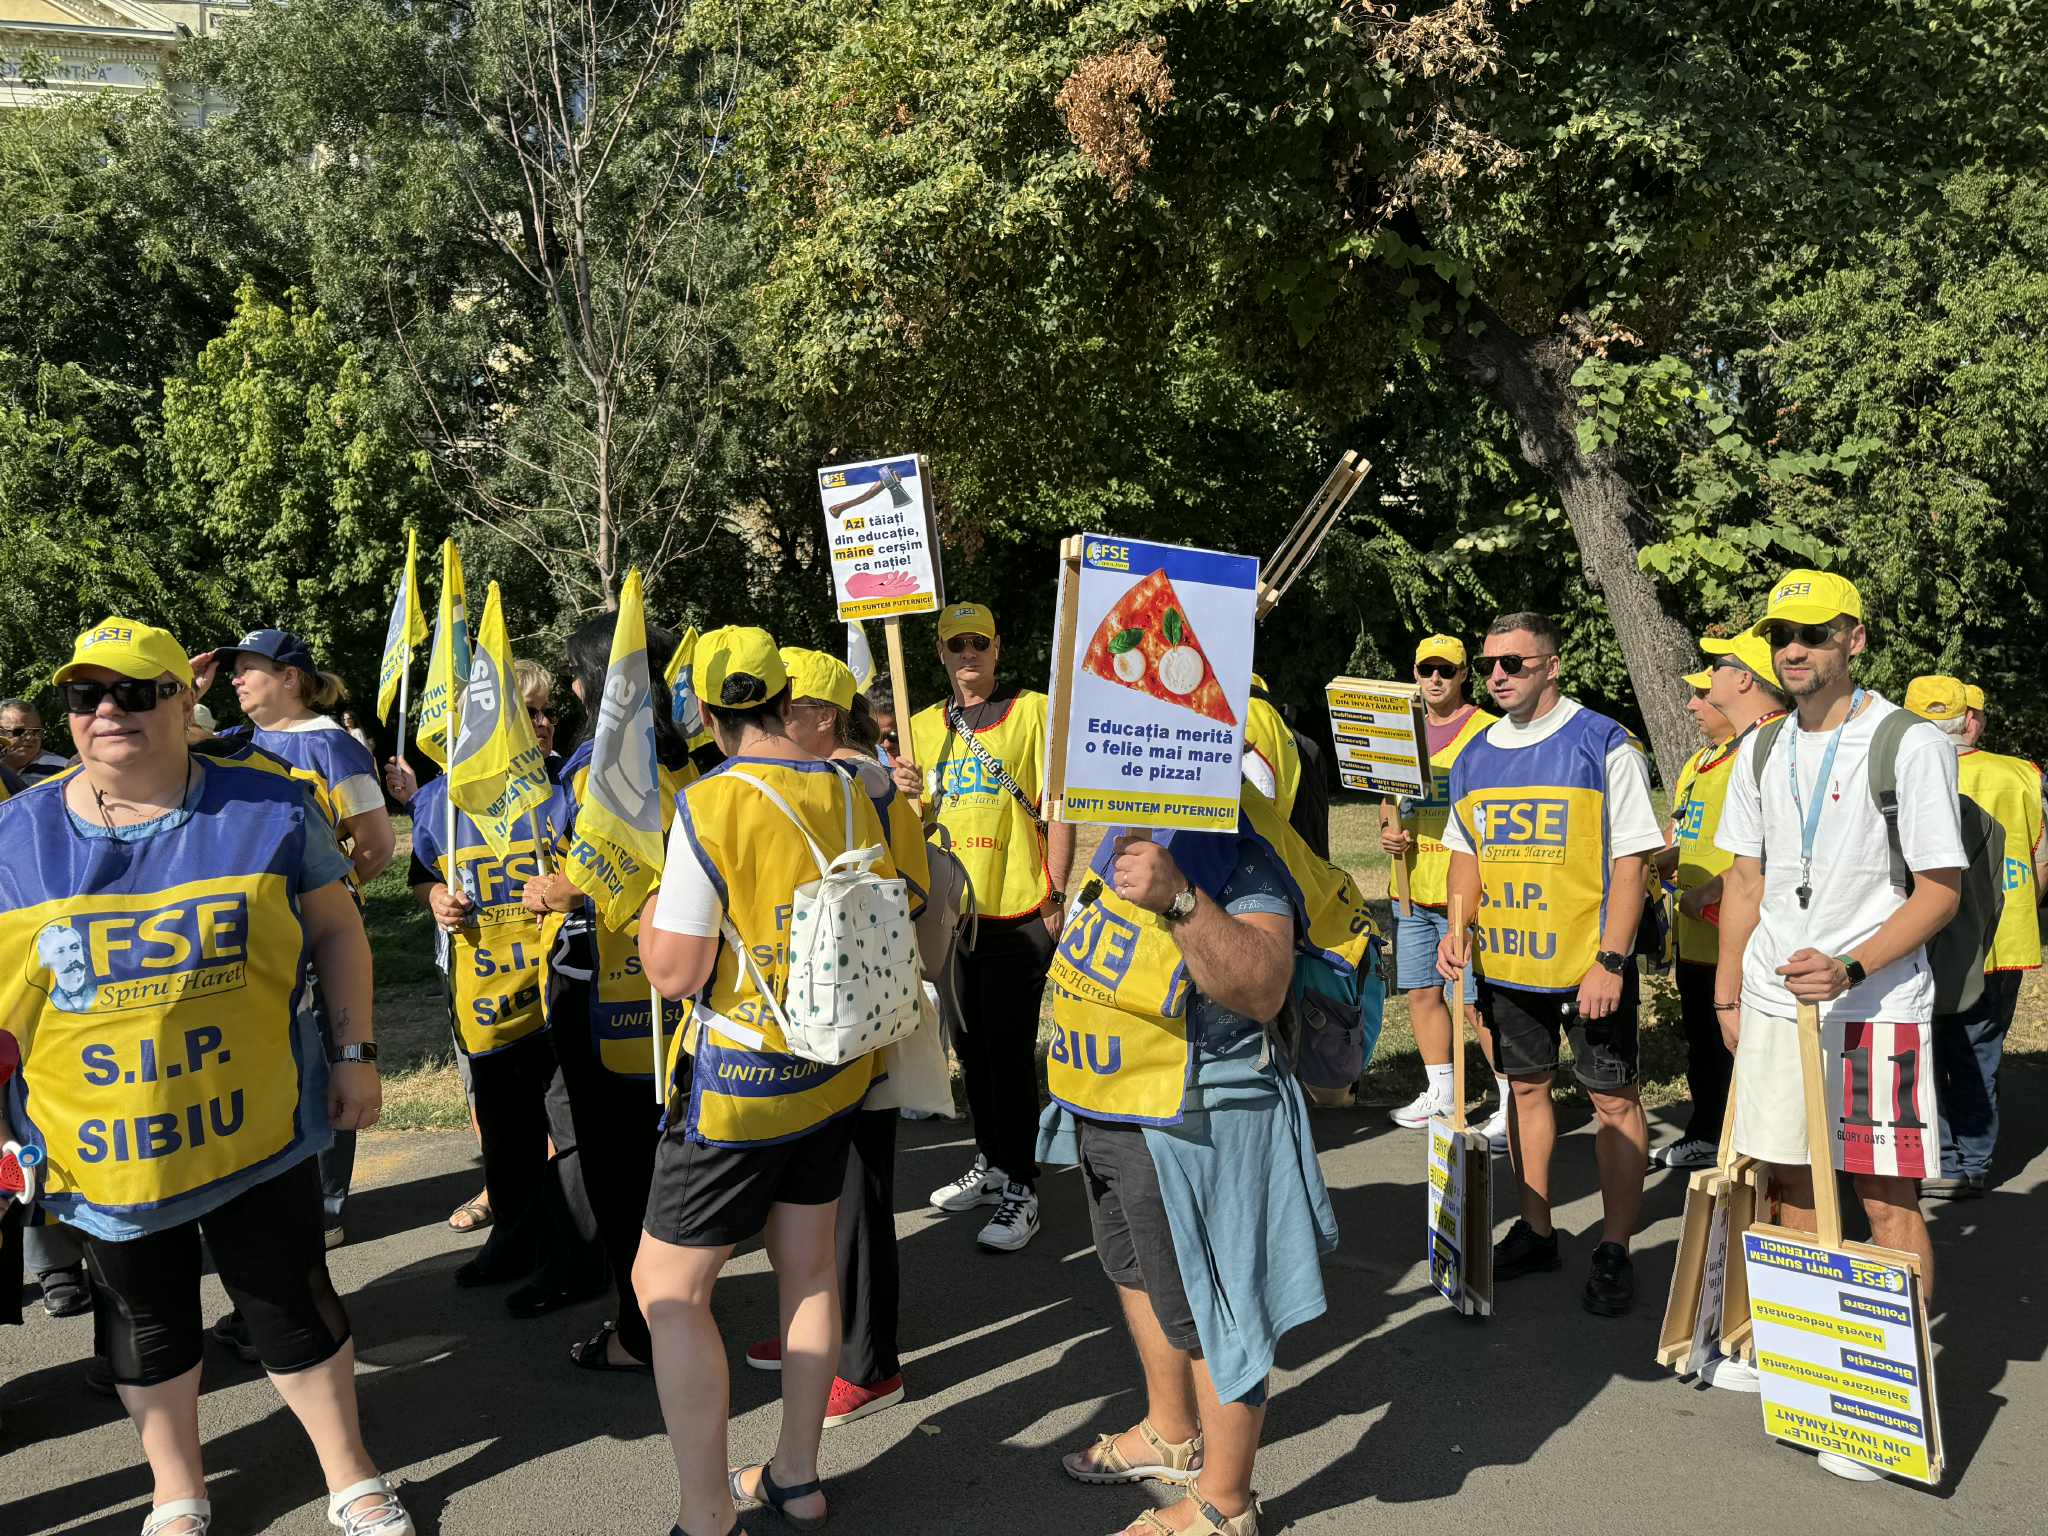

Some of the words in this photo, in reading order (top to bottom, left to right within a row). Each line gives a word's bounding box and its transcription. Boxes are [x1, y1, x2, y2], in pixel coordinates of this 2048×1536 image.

[845, 517, 864, 530] Azi
[869, 512, 904, 530] tăiați
[835, 534, 854, 546] din
[858, 526, 919, 543] educație,
[835, 546, 874, 560] mâine
[878, 540, 922, 555] cerșim
[1102, 544, 1129, 561] FSE
[854, 561, 870, 572] ca
[874, 555, 912, 571] nație!
[1782, 583, 1809, 595] FSE
[862, 600, 892, 611] SUNTEM
[892, 596, 933, 608] PUTERNICI!
[95, 628, 130, 641] FSE
[470, 659, 496, 711] SIP
[1088, 718, 1170, 742] Educația
[1176, 727, 1233, 745] merită
[1085, 742, 1096, 753] o
[1103, 739, 1143, 757] felie
[1149, 744, 1182, 760] mai
[1188, 750, 1233, 764] mare
[1121, 761, 1143, 777] de
[1149, 765, 1202, 781] pizza!
[1352, 776, 1368, 784] FSE
[1067, 797, 1103, 814] UNIȚI
[1107, 799, 1161, 814] SUNTEM
[1164, 804, 1235, 818] PUTERNICI!
[1486, 802, 1564, 842] FSE
[1486, 846, 1521, 861] Spiru
[1525, 846, 1564, 859] Haret
[476, 856, 536, 902] FS
[89, 900, 241, 977] FSE
[1061, 902, 1133, 981] FSE
[1478, 927, 1557, 960] SIBIU
[474, 942, 540, 977] S.I.
[100, 980, 169, 1009] Spiru
[176, 965, 242, 994] Haret
[1068, 970, 1113, 1004] Haret
[81, 1025, 231, 1087] S.I.P.
[1051, 1024, 1122, 1075] BIU
[718, 1061, 774, 1086] UNIȚI
[1840, 1048, 1928, 1128] 11
[77, 1088, 244, 1163] SIBIU
[1837, 1130, 1863, 1141] GLORY
[1864, 1134, 1886, 1144] DAYS
[1749, 1250, 1803, 1270] SUNTEM
[1805, 1259, 1843, 1278] UNIȚI
[1851, 1269, 1886, 1289] FSE
[1756, 1304, 1833, 1331] nedecontată
[1843, 1299, 1907, 1322] Politizare
[1836, 1324, 1882, 1344] Navetă
[1761, 1357, 1839, 1385] nemotivantă
[1846, 1353, 1914, 1380] Birocrație
[1842, 1378, 1908, 1404] Salarizare
[1833, 1400, 1919, 1434] Subfinanțare
[1784, 1427, 1901, 1468] „PRIVILEGIILE”
[1882, 1439, 1911, 1457] DIN
